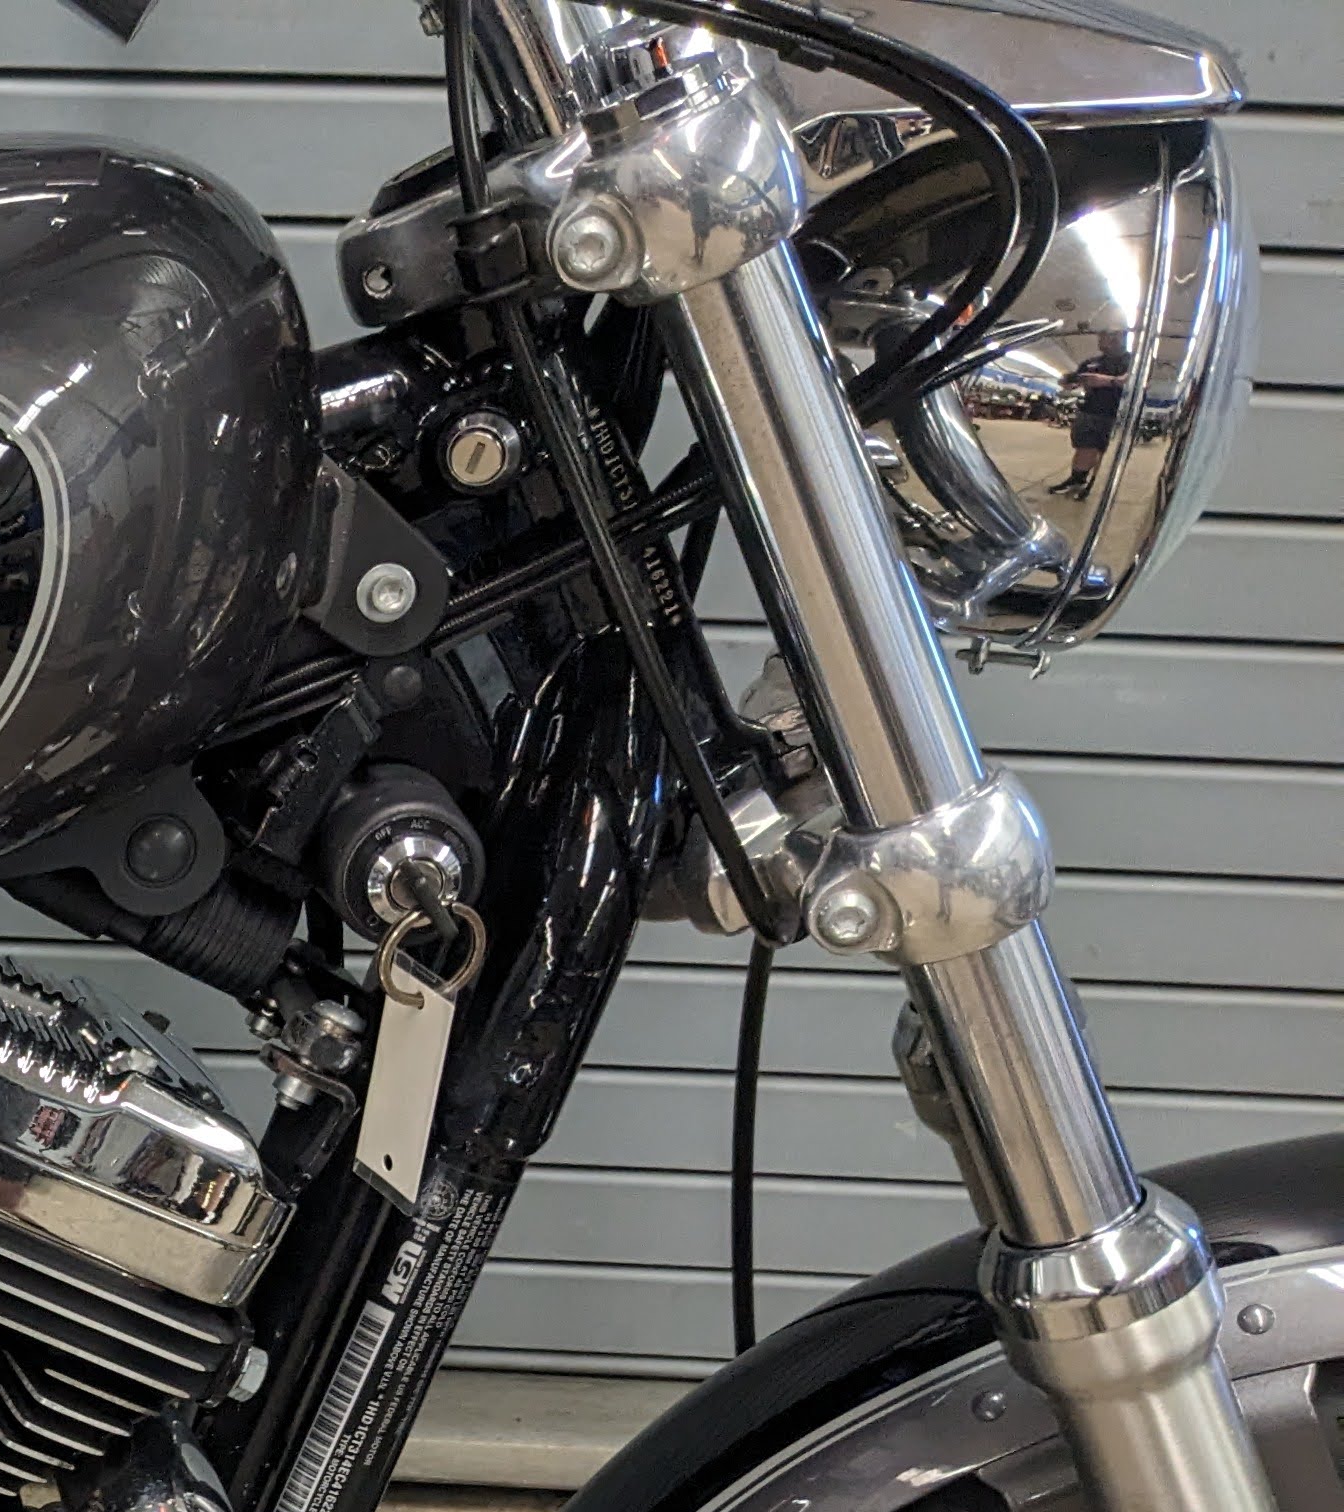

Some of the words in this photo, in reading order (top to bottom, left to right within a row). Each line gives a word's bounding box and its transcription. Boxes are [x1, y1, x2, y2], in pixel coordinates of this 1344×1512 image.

[375, 825, 392, 840] OFF
[458, 1185, 474, 1207] THE
[461, 1188, 484, 1229] VEHICLE
[447, 1205, 465, 1231] DATE
[460, 1212, 483, 1252] VEHICLE
[445, 1227, 467, 1262] SAFETY
[412, 1242, 448, 1309] MANUFACTURE
[421, 1261, 451, 1315] STANDARDS
[437, 1250, 466, 1302] CONFORMS
[397, 1307, 418, 1341] SHOWN
[401, 1323, 423, 1359] EFFECT
[383, 1339, 404, 1372] ABOVE
[401, 1330, 430, 1384] APPLICABLE
[333, 1431, 351, 1459] TYPE:
[362, 1434, 382, 1468] MOTOR
